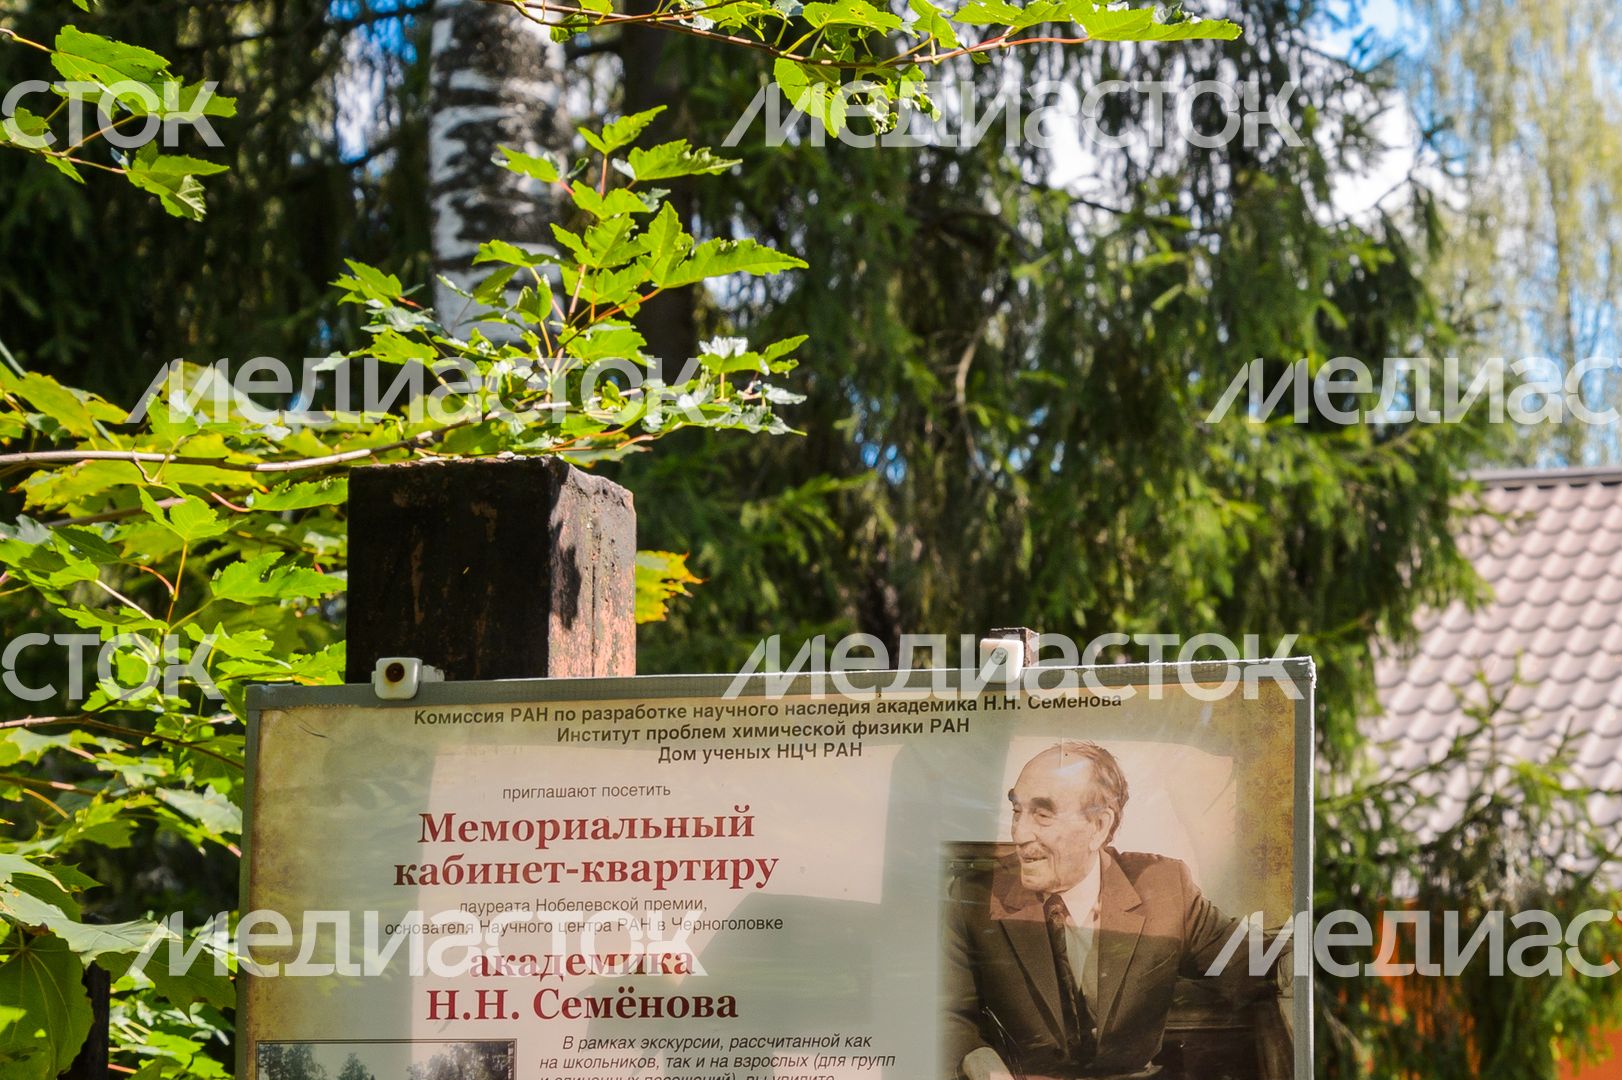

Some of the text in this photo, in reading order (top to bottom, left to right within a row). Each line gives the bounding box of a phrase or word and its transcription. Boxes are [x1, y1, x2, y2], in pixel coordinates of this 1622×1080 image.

[415, 710, 504, 724] Комиссия
[511, 707, 548, 722] РАН
[555, 710, 575, 721] по
[582, 704, 684, 726] разработке
[693, 705, 778, 721] научного
[785, 703, 870, 717] наследия
[877, 700, 977, 715] академика
[1028, 694, 1121, 709] Семенова
[558, 718, 969, 745] Институт проблем химической физики РАН
[658, 742, 862, 764] Дом ученых НЦЧ РАН
[503, 786, 670, 802] приглашают посетить
[418, 805, 755, 849] Мемориальный
[394, 853, 779, 890] кабинет-квартиру
[460, 897, 707, 917] лауреата Нобелевской премии,
[385, 917, 783, 936] основателя Научного центра РАН в Черноголовке
[470, 953, 692, 982] академика
[534, 986, 738, 1019] Семёнова
[563, 1034, 872, 1053] В рамках экскурсии, рассчитанной как
[540, 1053, 895, 1071] на школьников, так и на взрослых (для групп
